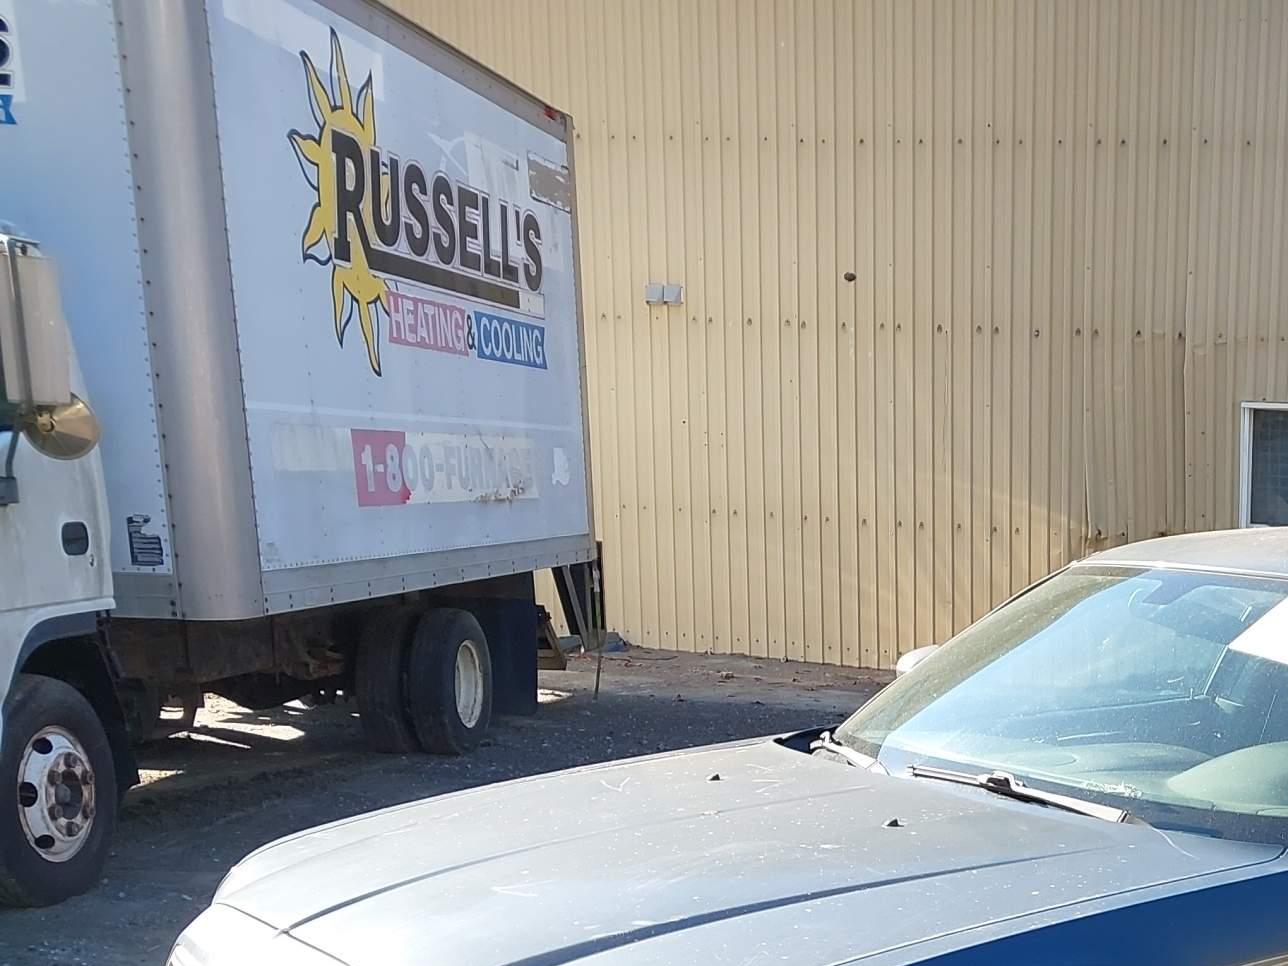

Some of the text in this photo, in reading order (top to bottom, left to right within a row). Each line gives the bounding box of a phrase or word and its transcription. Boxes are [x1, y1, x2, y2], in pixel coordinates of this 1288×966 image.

[331, 128, 543, 293] RUSSELL'S
[389, 295, 466, 352] HEATING
[480, 316, 543, 365] COOLING
